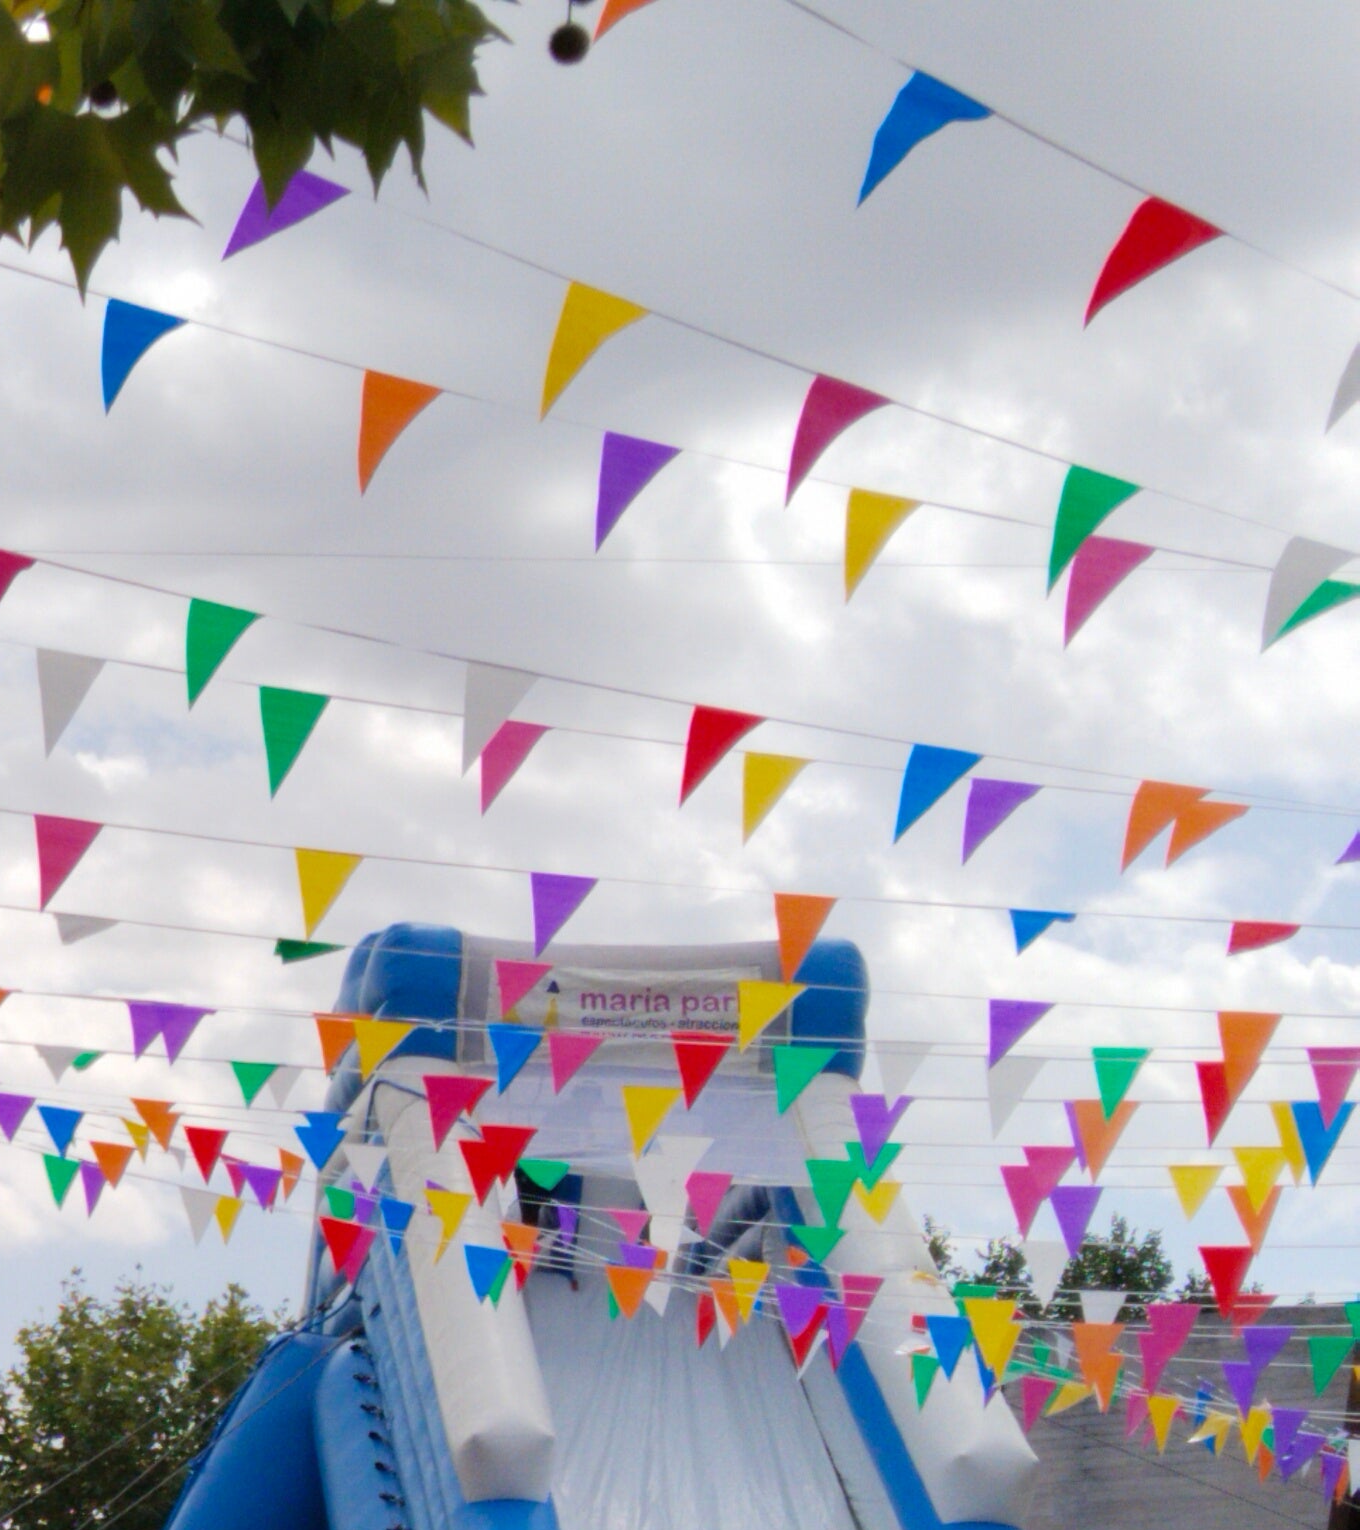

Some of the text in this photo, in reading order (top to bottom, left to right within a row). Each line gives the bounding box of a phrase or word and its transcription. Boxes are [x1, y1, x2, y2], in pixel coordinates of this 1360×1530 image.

[580, 987, 741, 1016] maria par
[677, 1017, 740, 1031] atraccion
